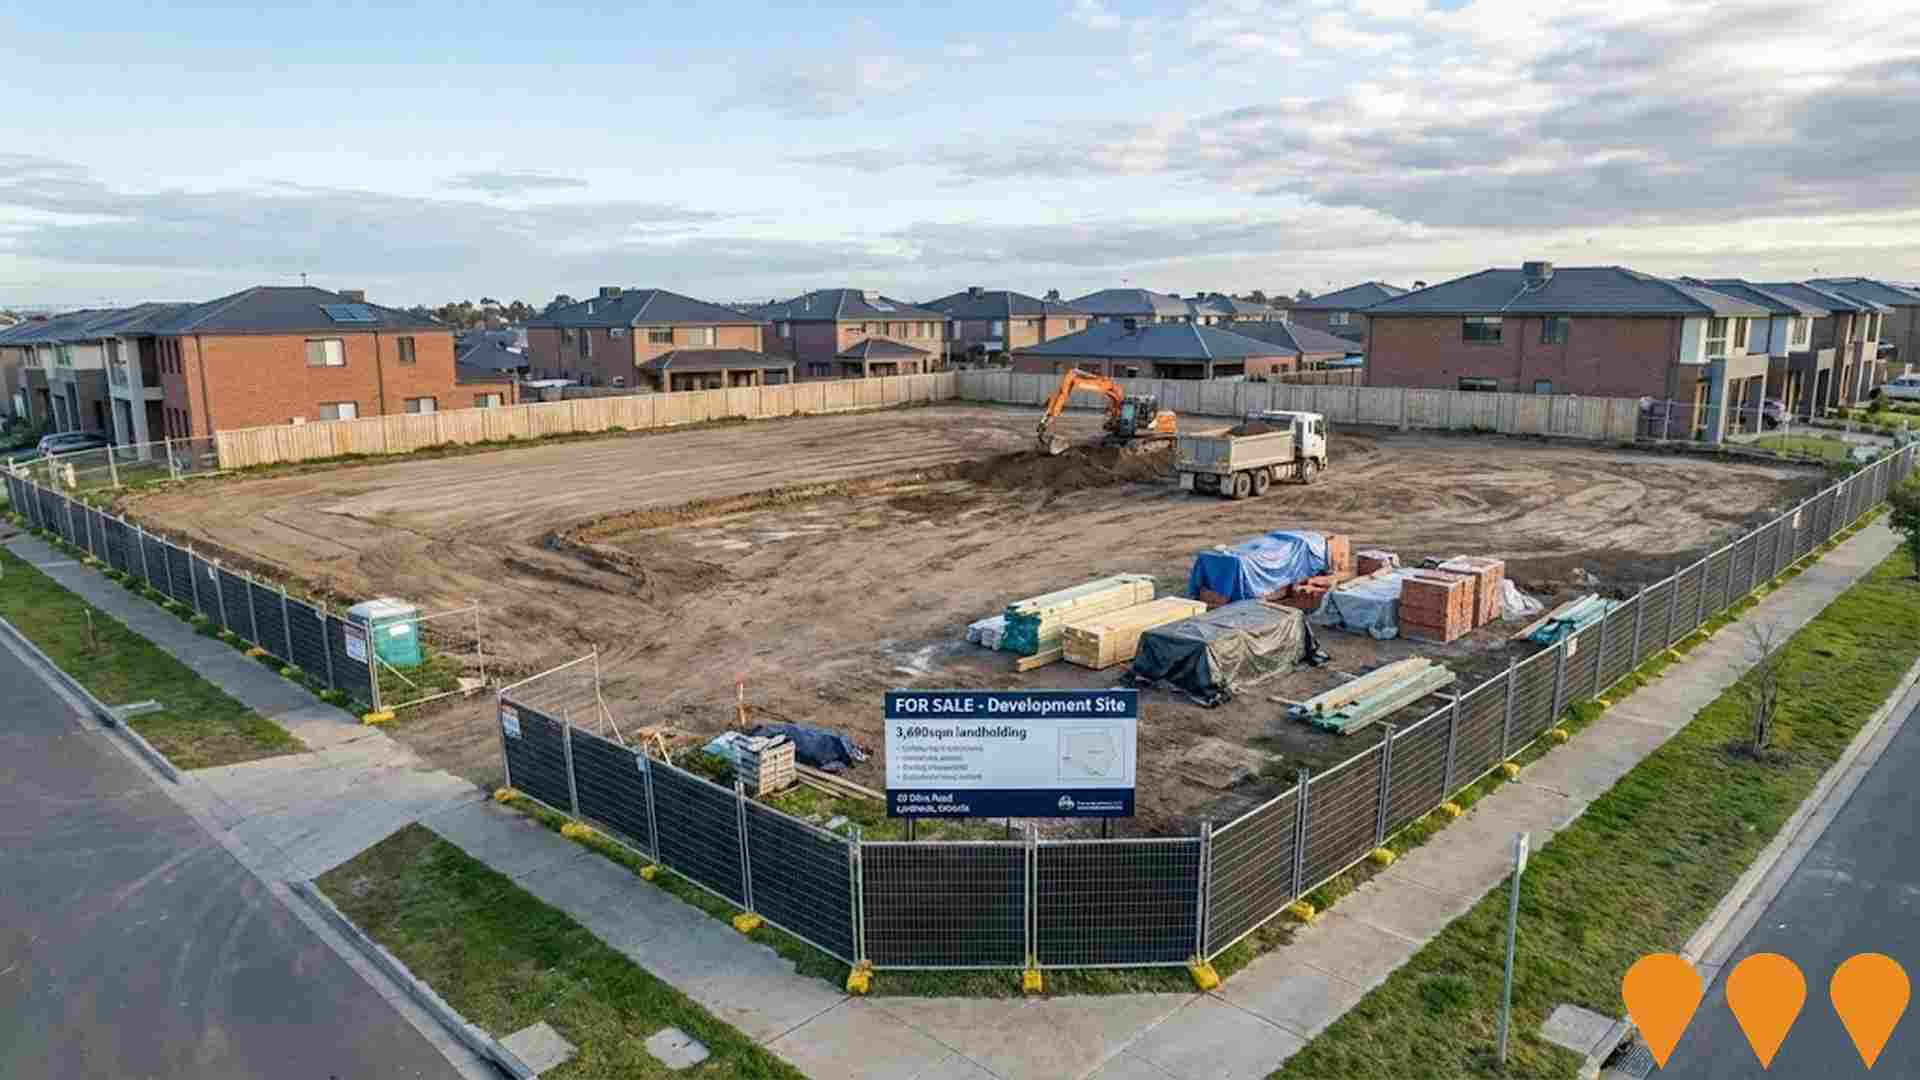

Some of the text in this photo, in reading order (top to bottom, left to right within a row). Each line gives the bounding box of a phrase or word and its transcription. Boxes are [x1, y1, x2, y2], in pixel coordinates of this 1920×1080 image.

[896, 698, 929, 713] FOR
[933, 698, 974, 713] SALE
[987, 697, 1092, 715] Development
[1095, 697, 1126, 713] Site
[955, 725, 1027, 741] landholding
